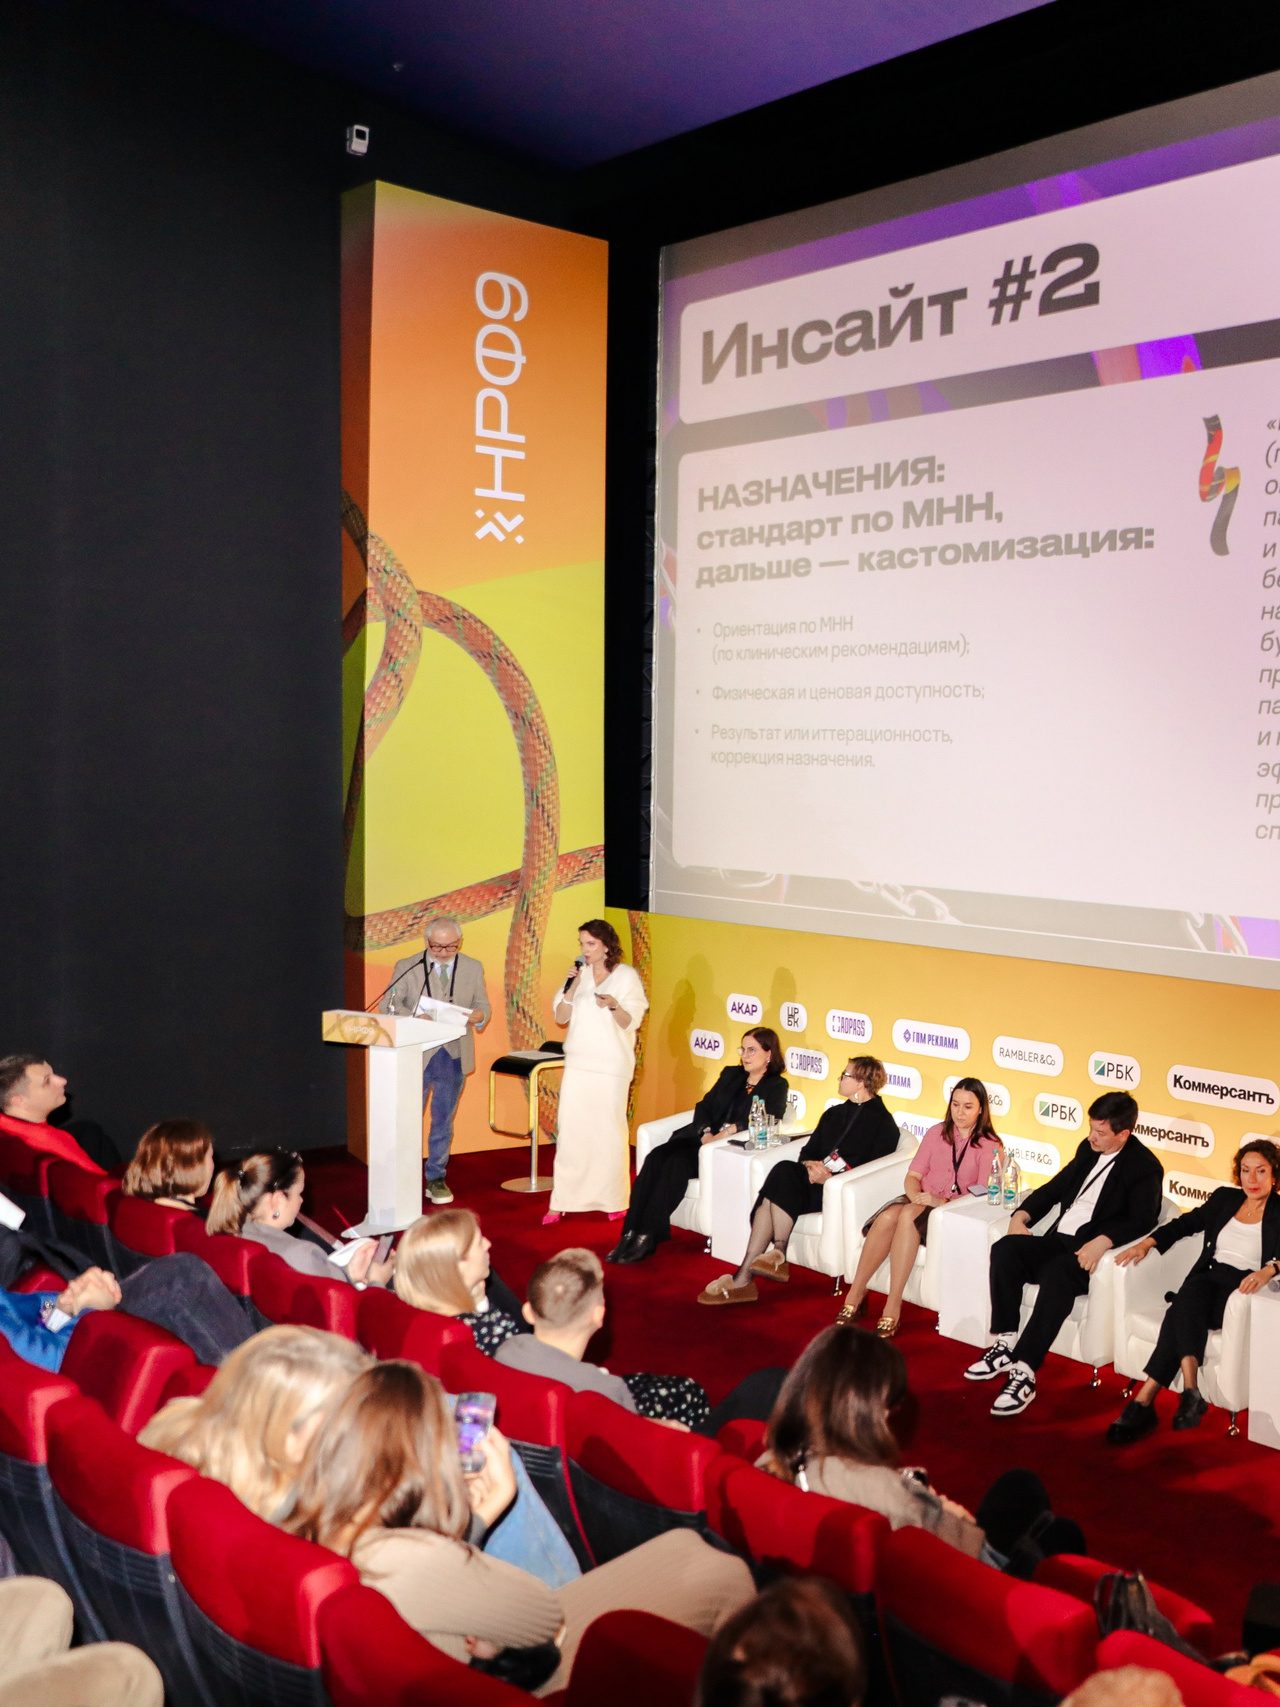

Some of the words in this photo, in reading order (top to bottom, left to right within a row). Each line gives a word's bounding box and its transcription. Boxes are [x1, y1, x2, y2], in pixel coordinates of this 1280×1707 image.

[701, 282, 968, 386] Инсайт
[988, 243, 1100, 325] #2
[475, 271, 529, 502] НРФ9
[699, 455, 945, 512] НАЗНАЧЕНИЯ:
[698, 517, 843, 549] стандарт
[852, 511, 893, 534] по
[903, 491, 1003, 529] МНН,
[696, 558, 811, 588] дальше
[858, 527, 1154, 572] кастомизация:
[713, 621, 796, 640] Ориентация
[799, 620, 816, 633] по
[819, 614, 853, 632] МНН
[712, 645, 733, 664] (по
[736, 645, 828, 660] клиническим
[830, 632, 969, 662] рекомендациям);
[712, 685, 795, 700] Физическая
[797, 687, 806, 699] и
[809, 685, 871, 701] ценовая
[874, 683, 984, 703] доступность;
[711, 723, 781, 742] Результат
[784, 728, 809, 740] или
[811, 728, 953, 746] иттерационность,
[710, 751, 784, 767] коррекция
[785, 752, 875, 767] назначения.
[730, 1001, 758, 1017] АКАР
[693, 1036, 720, 1051] АКАР
[912, 1030, 926, 1045] ГПМ
[927, 1036, 959, 1051] РЕКЛАМА
[1106, 1062, 1134, 1082] РБК
[1173, 1074, 1275, 1105] Коммерсантъ
[1051, 1102, 1077, 1123] РБК
[1133, 1123, 1210, 1148] ммерсантъ
